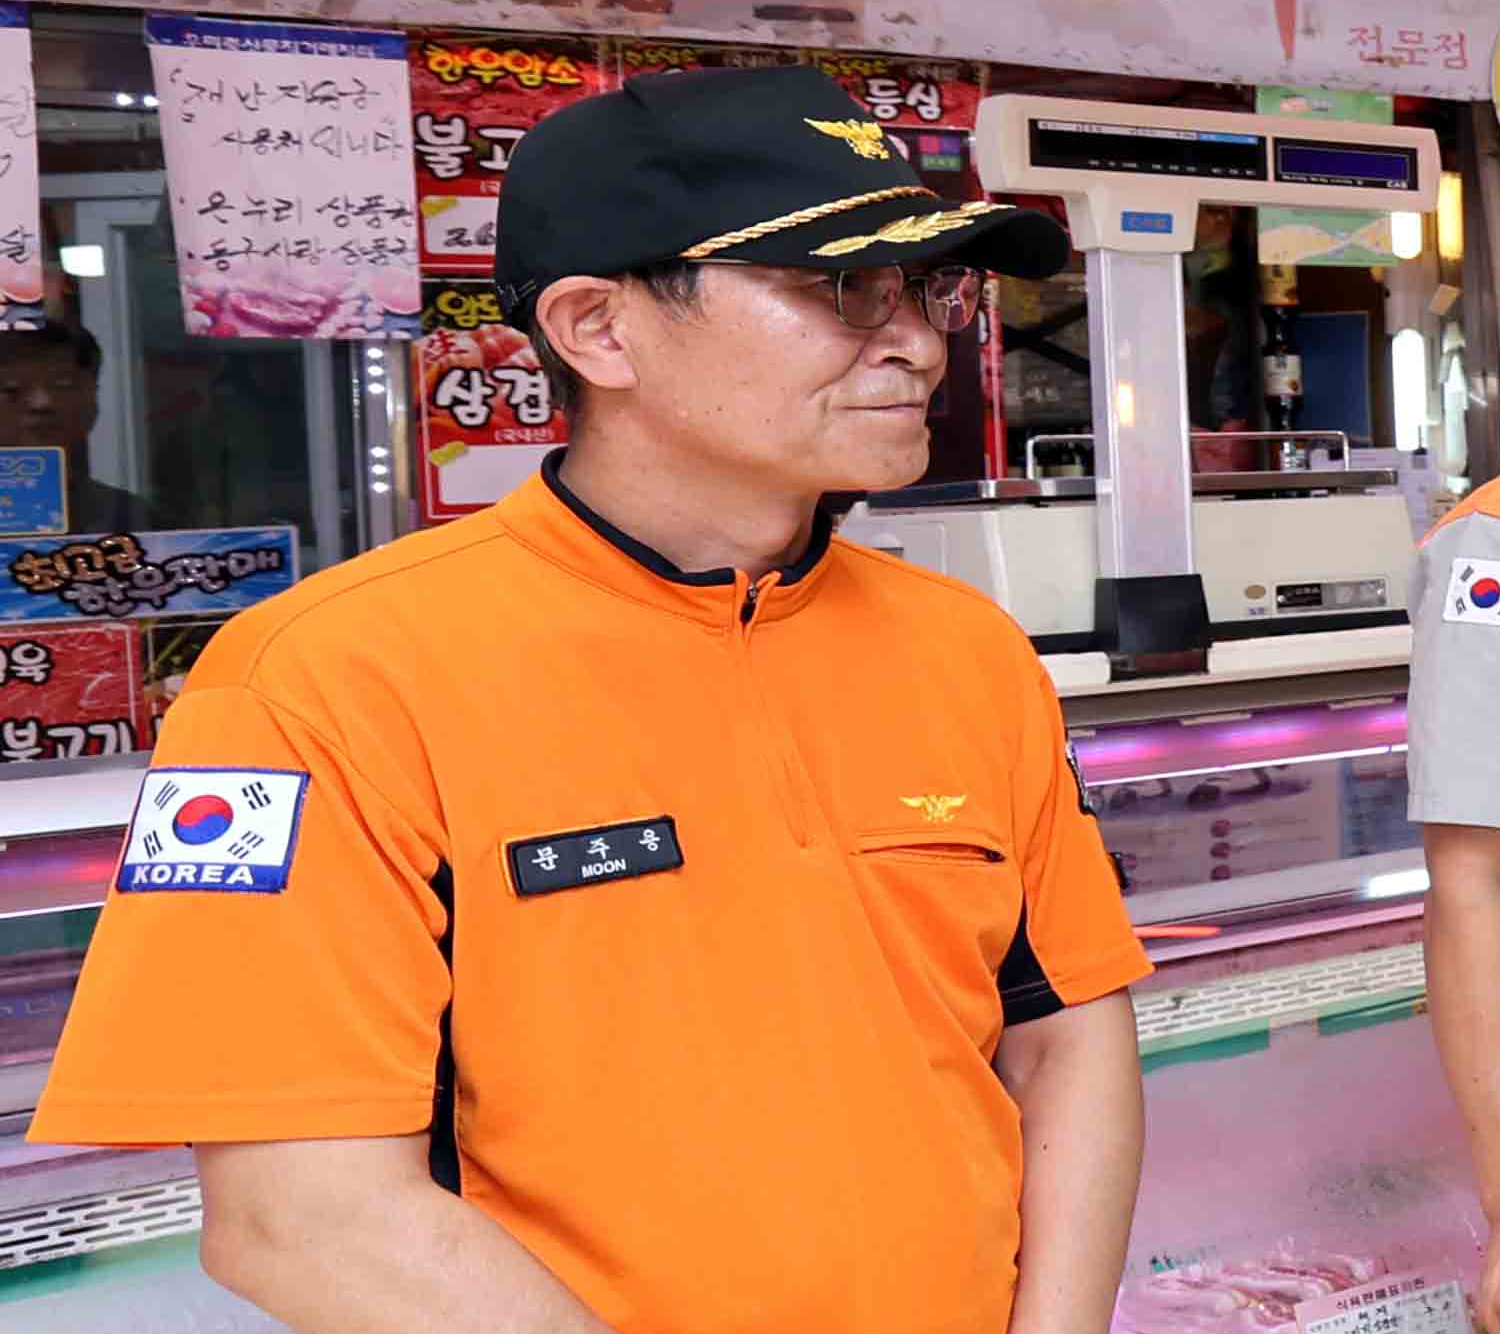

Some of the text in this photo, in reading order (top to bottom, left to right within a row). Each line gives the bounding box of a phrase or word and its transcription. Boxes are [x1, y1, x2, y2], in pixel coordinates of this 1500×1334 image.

[426, 45, 583, 85] 한우암소
[1346, 24, 1468, 69] 전문점
[414, 114, 528, 181] 불고
[531, 828, 662, 871] 문 주 용
[581, 857, 627, 879] MOON
[132, 864, 255, 886] KOREA
